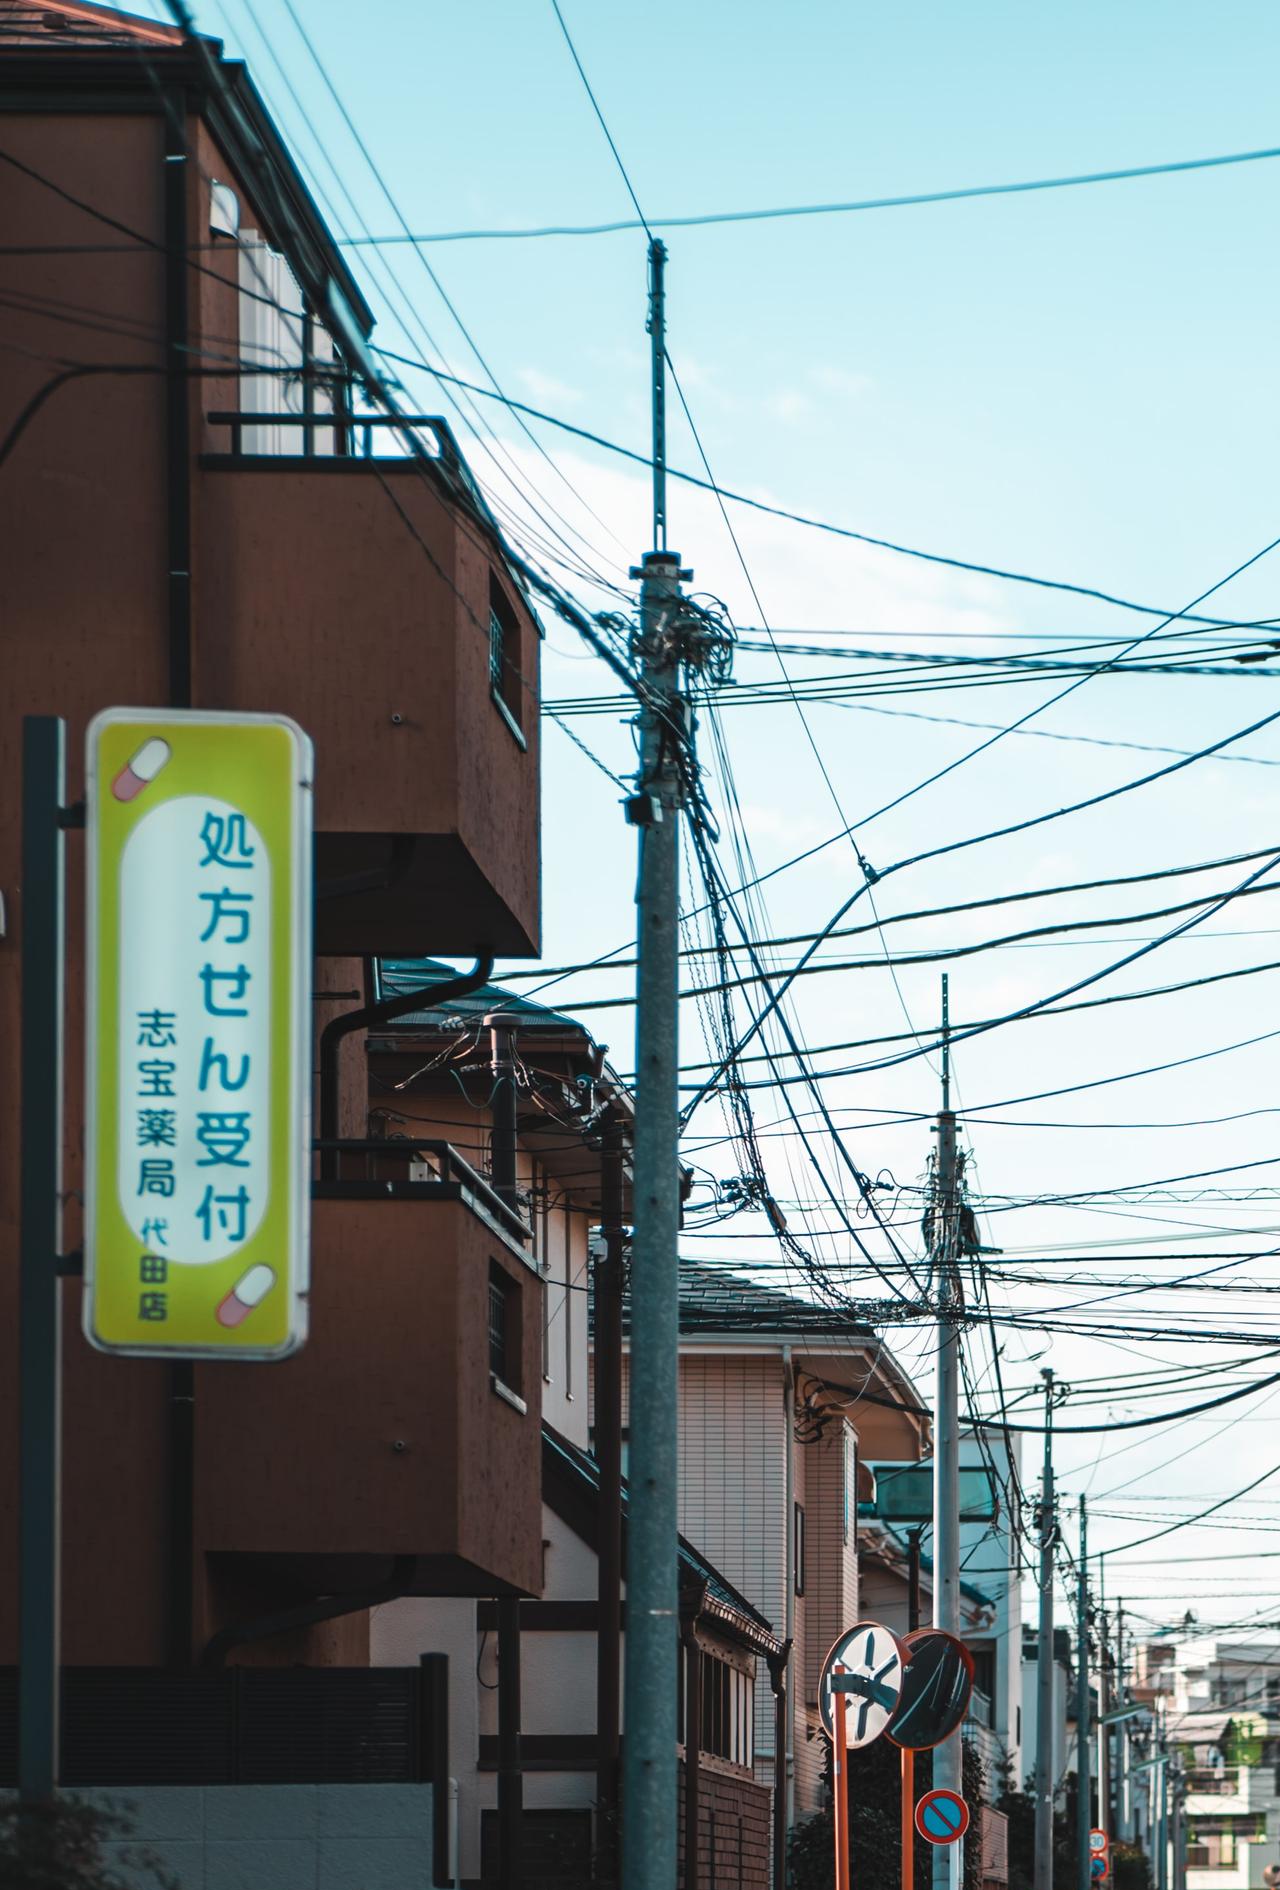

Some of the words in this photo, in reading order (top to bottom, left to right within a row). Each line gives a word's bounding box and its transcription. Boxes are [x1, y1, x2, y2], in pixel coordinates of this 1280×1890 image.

[136, 1008, 177, 1197] 志宝薬局
[195, 810, 255, 1242] 処方せん受付
[138, 1216, 168, 1322] 代田店
